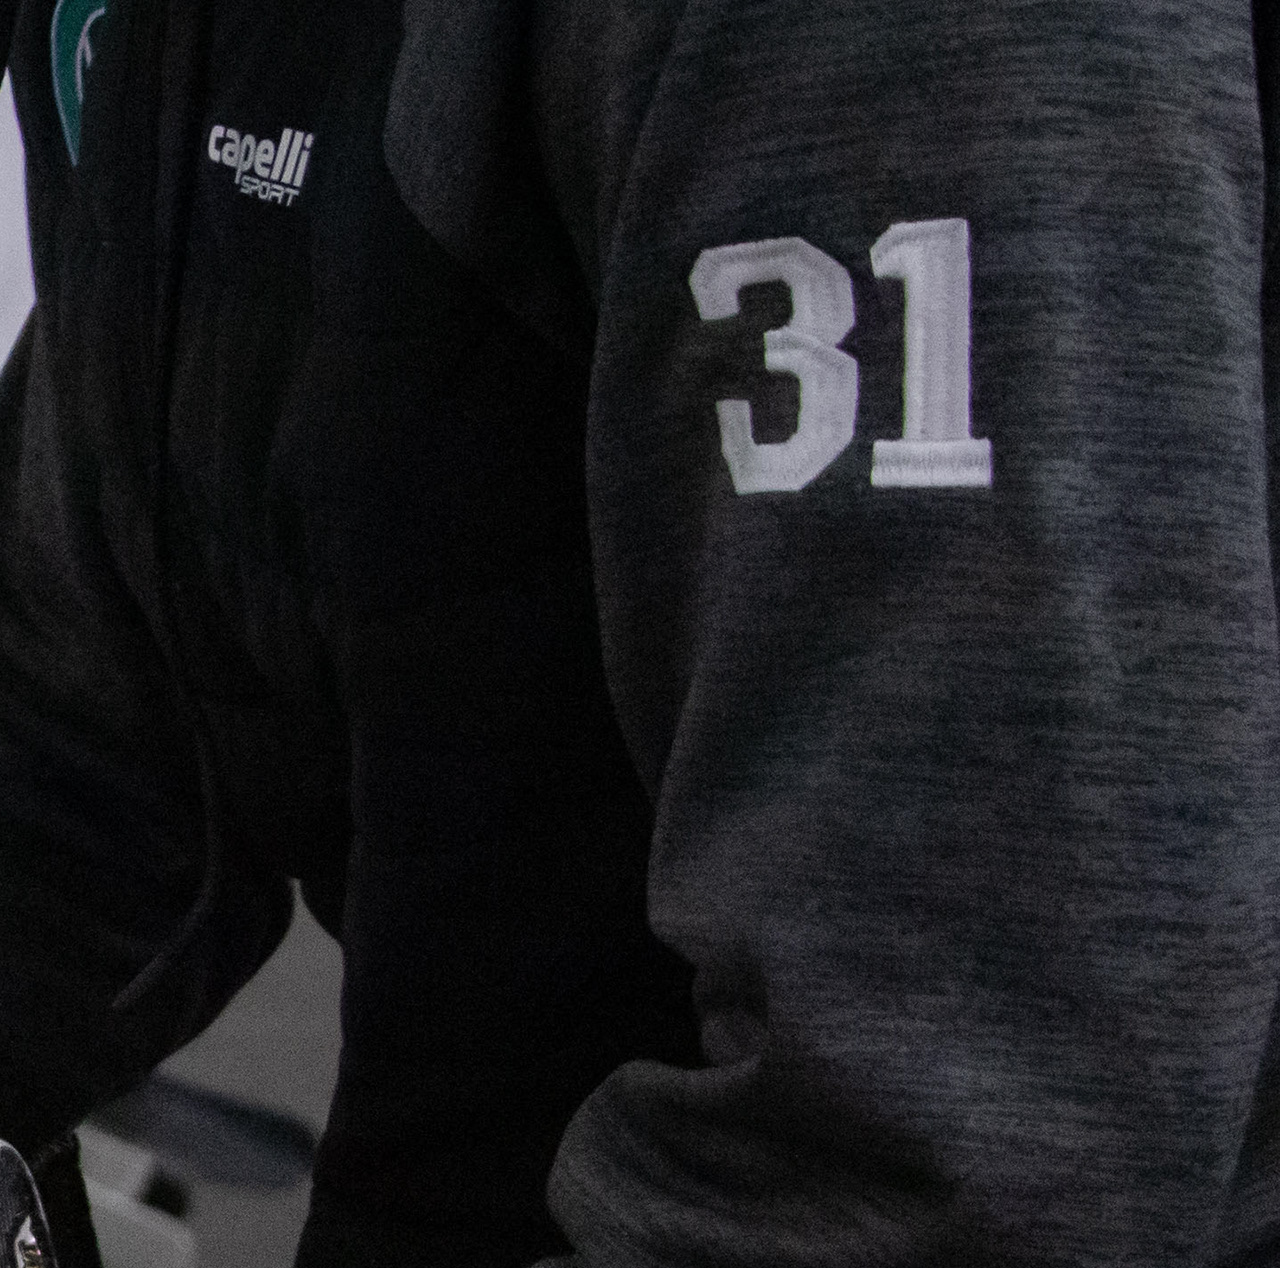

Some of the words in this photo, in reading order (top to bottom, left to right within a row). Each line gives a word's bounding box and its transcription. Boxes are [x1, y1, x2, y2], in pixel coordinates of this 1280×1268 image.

[207, 125, 314, 187] capelli
[239, 174, 301, 207] SPORT
[688, 217, 994, 495] 31
